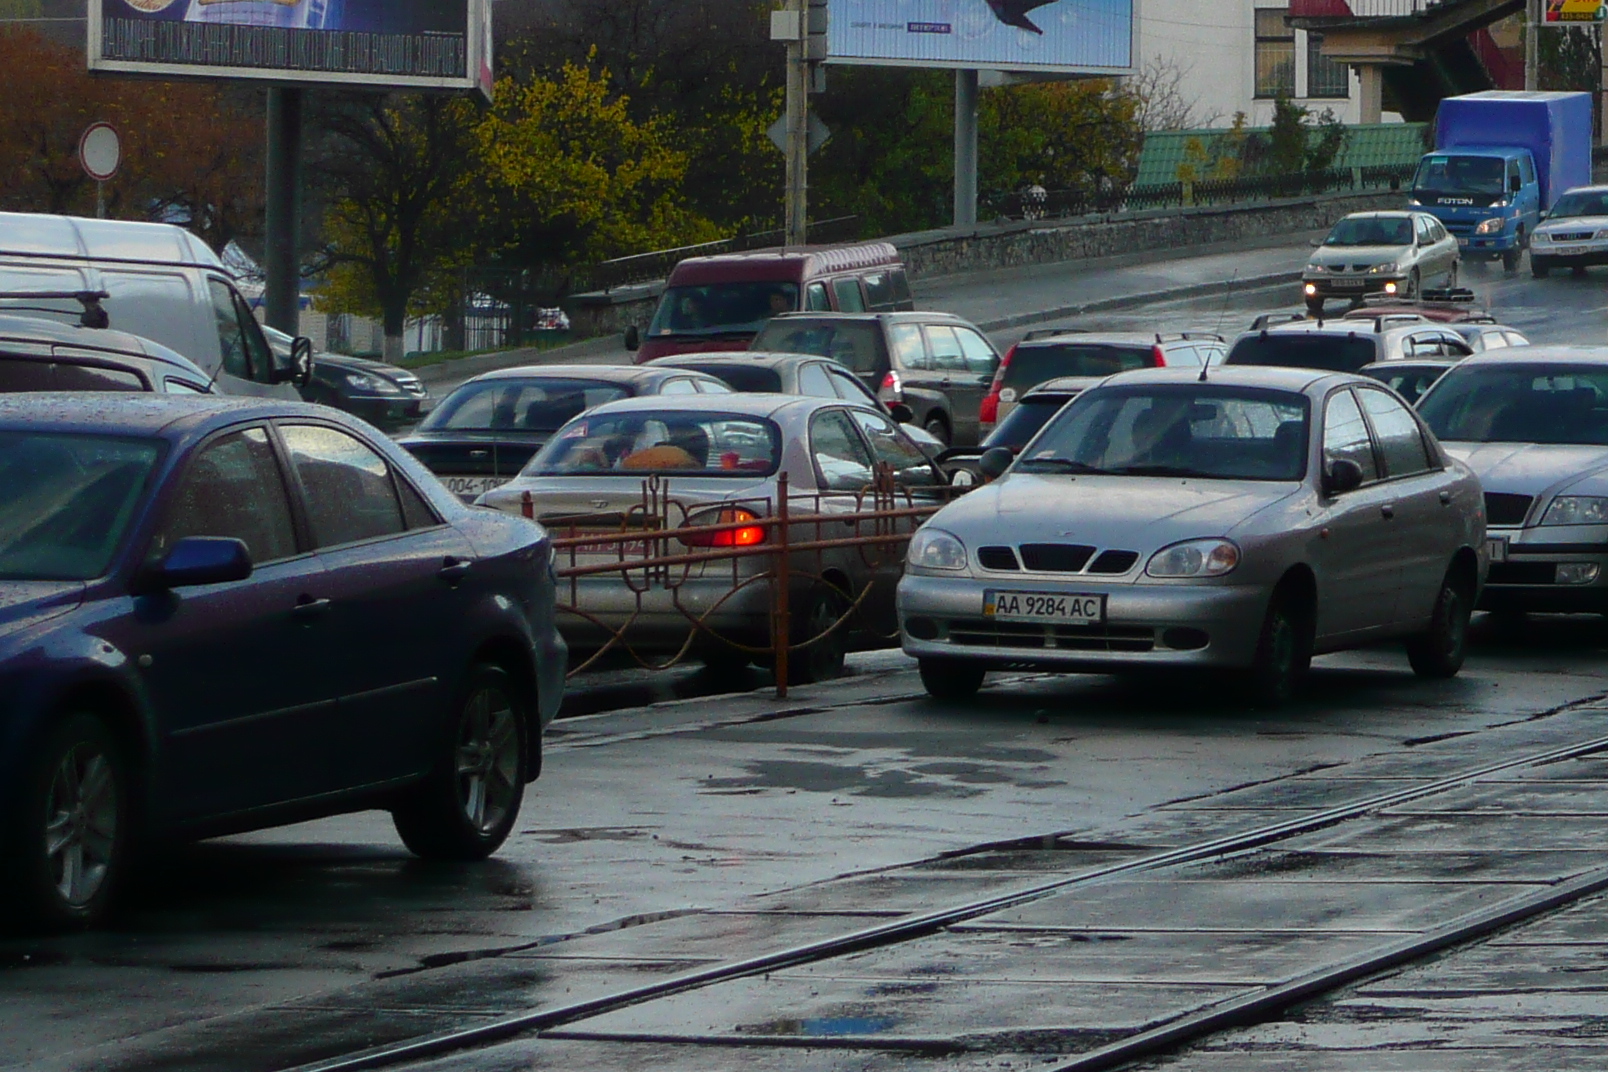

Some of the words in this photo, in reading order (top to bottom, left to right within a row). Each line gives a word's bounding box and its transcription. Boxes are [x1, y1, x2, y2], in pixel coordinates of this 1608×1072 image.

[1437, 197, 1473, 205] FOTON
[996, 595, 1020, 614] AA
[1026, 597, 1066, 616] 9284
[1070, 599, 1096, 617] AC
